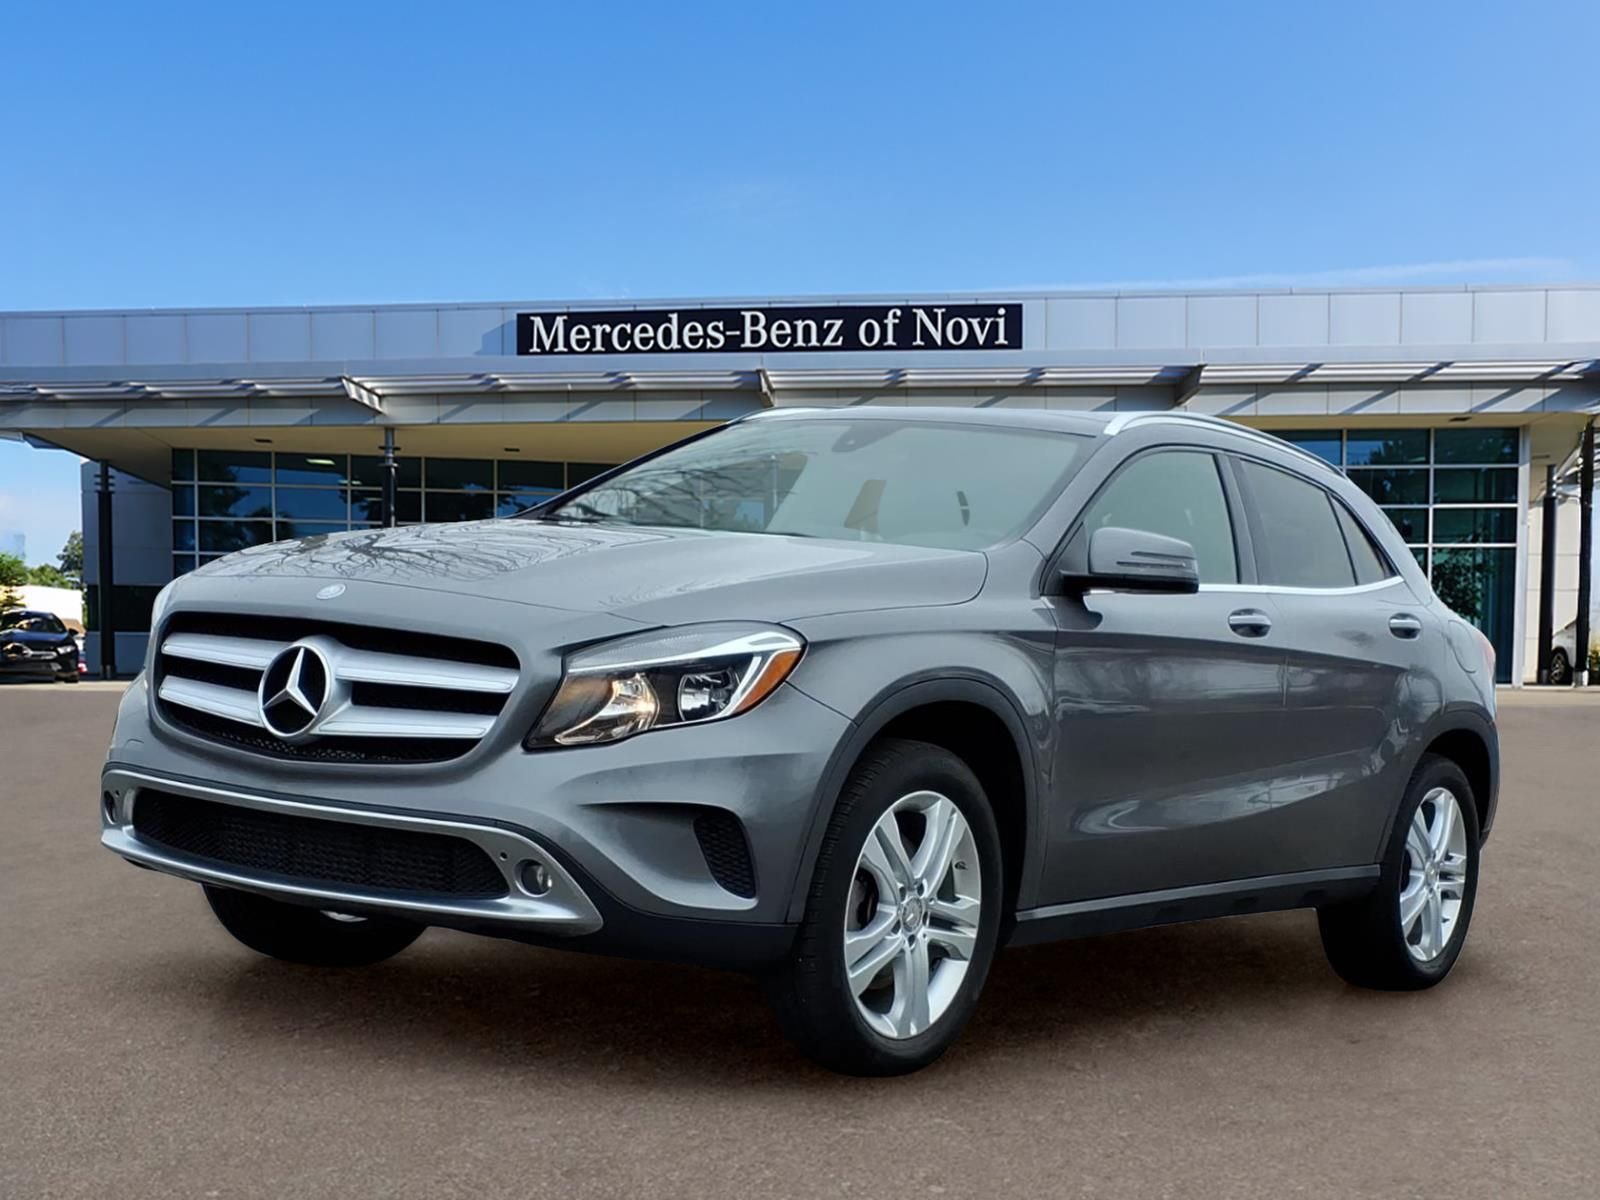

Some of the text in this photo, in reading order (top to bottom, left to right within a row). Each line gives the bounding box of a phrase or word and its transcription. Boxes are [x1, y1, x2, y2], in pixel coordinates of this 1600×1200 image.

[529, 307, 1009, 352] Mercedes-Benz of Novi
